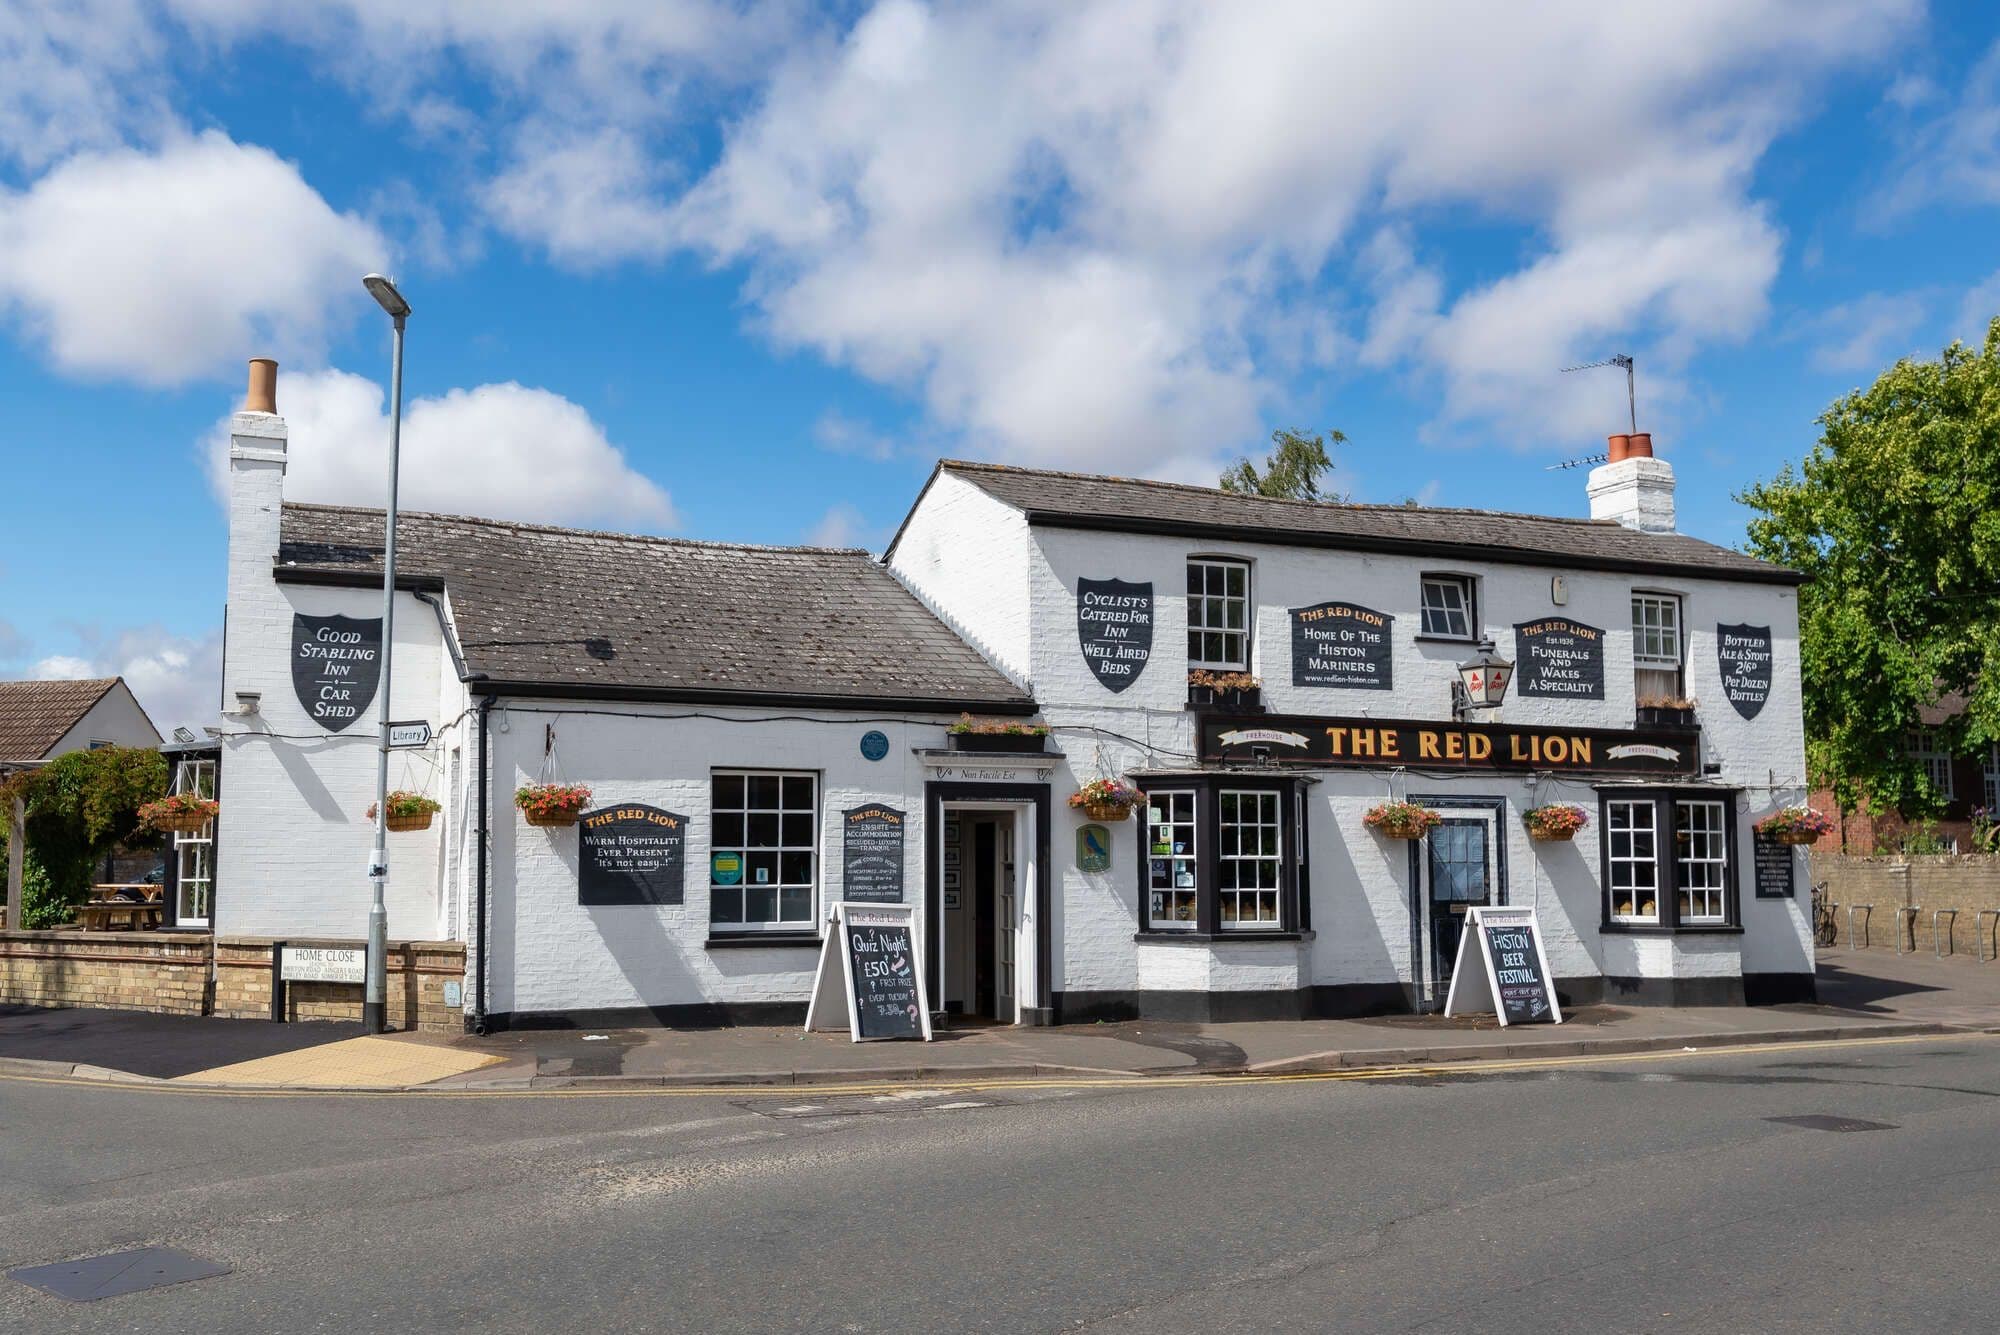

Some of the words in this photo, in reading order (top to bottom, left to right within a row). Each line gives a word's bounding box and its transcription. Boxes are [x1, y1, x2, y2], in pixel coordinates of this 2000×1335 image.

[1084, 592, 1148, 608] CYCLISTS
[1081, 608, 1128, 621] CATERED
[1130, 610, 1149, 624] FOR
[1300, 609, 1324, 622] THE
[1327, 608, 1351, 617] RED
[1355, 610, 1383, 626] LION
[316, 626, 361, 643] GOOD
[1104, 624, 1128, 638] INN
[1304, 628, 1336, 640] HOME
[1340, 630, 1355, 641] OF
[1358, 631, 1380, 642] THE
[1522, 624, 1543, 636] THE
[1545, 622, 1567, 631] RED
[1570, 625, 1596, 640] LION
[1725, 634, 1765, 647] BOTTLED
[300, 643, 375, 660] STABLING
[1084, 643, 1113, 658] WELL
[1116, 646, 1148, 660] AIRED
[1319, 644, 1366, 657] HISTON
[1531, 646, 1589, 660] FUNERALS
[1720, 648, 1736, 659] ALE
[1737, 649, 1743, 660] &
[1744, 649, 1770, 661] STOUT
[324, 661, 350, 676] INN
[1100, 660, 1131, 674] BEDS
[1309, 658, 1376, 672] MARINERS
[1540, 666, 1580, 678] WAKES
[1529, 680, 1538, 690] A
[1540, 680, 1593, 692] SPECIALITY
[1741, 676, 1768, 689] DOZEN
[320, 686, 350, 700] CAR
[1730, 689, 1764, 701] BOTTLES
[314, 702, 356, 717] SHED
[393, 730, 422, 740] Library
[1245, 732, 1284, 741] FREEHOUSE
[1326, 727, 1400, 756] THE
[1418, 730, 1492, 759] RED
[1510, 734, 1592, 762] LION
[961, 768, 977, 779] Non
[1003, 769, 1016, 780] Est
[586, 813, 614, 829] THE
[617, 809, 644, 820] RED
[648, 812, 678, 830] LION
[849, 814, 864, 822] THE
[882, 812, 900, 824] LION
[584, 836, 615, 845] WARM
[618, 836, 680, 845] HOSPITALITY
[597, 848, 621, 857] EVER
[626, 848, 670, 857] PRESENT
[616, 859, 634, 867] not
[848, 912, 865, 921] The
[869, 913, 884, 922] Red
[887, 914, 905, 923] Lion
[853, 934, 878, 952] Quiz
[880, 934, 908, 958] Night
[1493, 934, 1528, 949] HISTON
[296, 950, 322, 961] HOME
[326, 951, 355, 962] CLOSE
[1502, 953, 1526, 966] BEER
[864, 961, 889, 977] £50
[1498, 968, 1538, 984] FESTIVAL
[880, 979, 896, 987] FIRST
[869, 994, 885, 1002] EVERY
